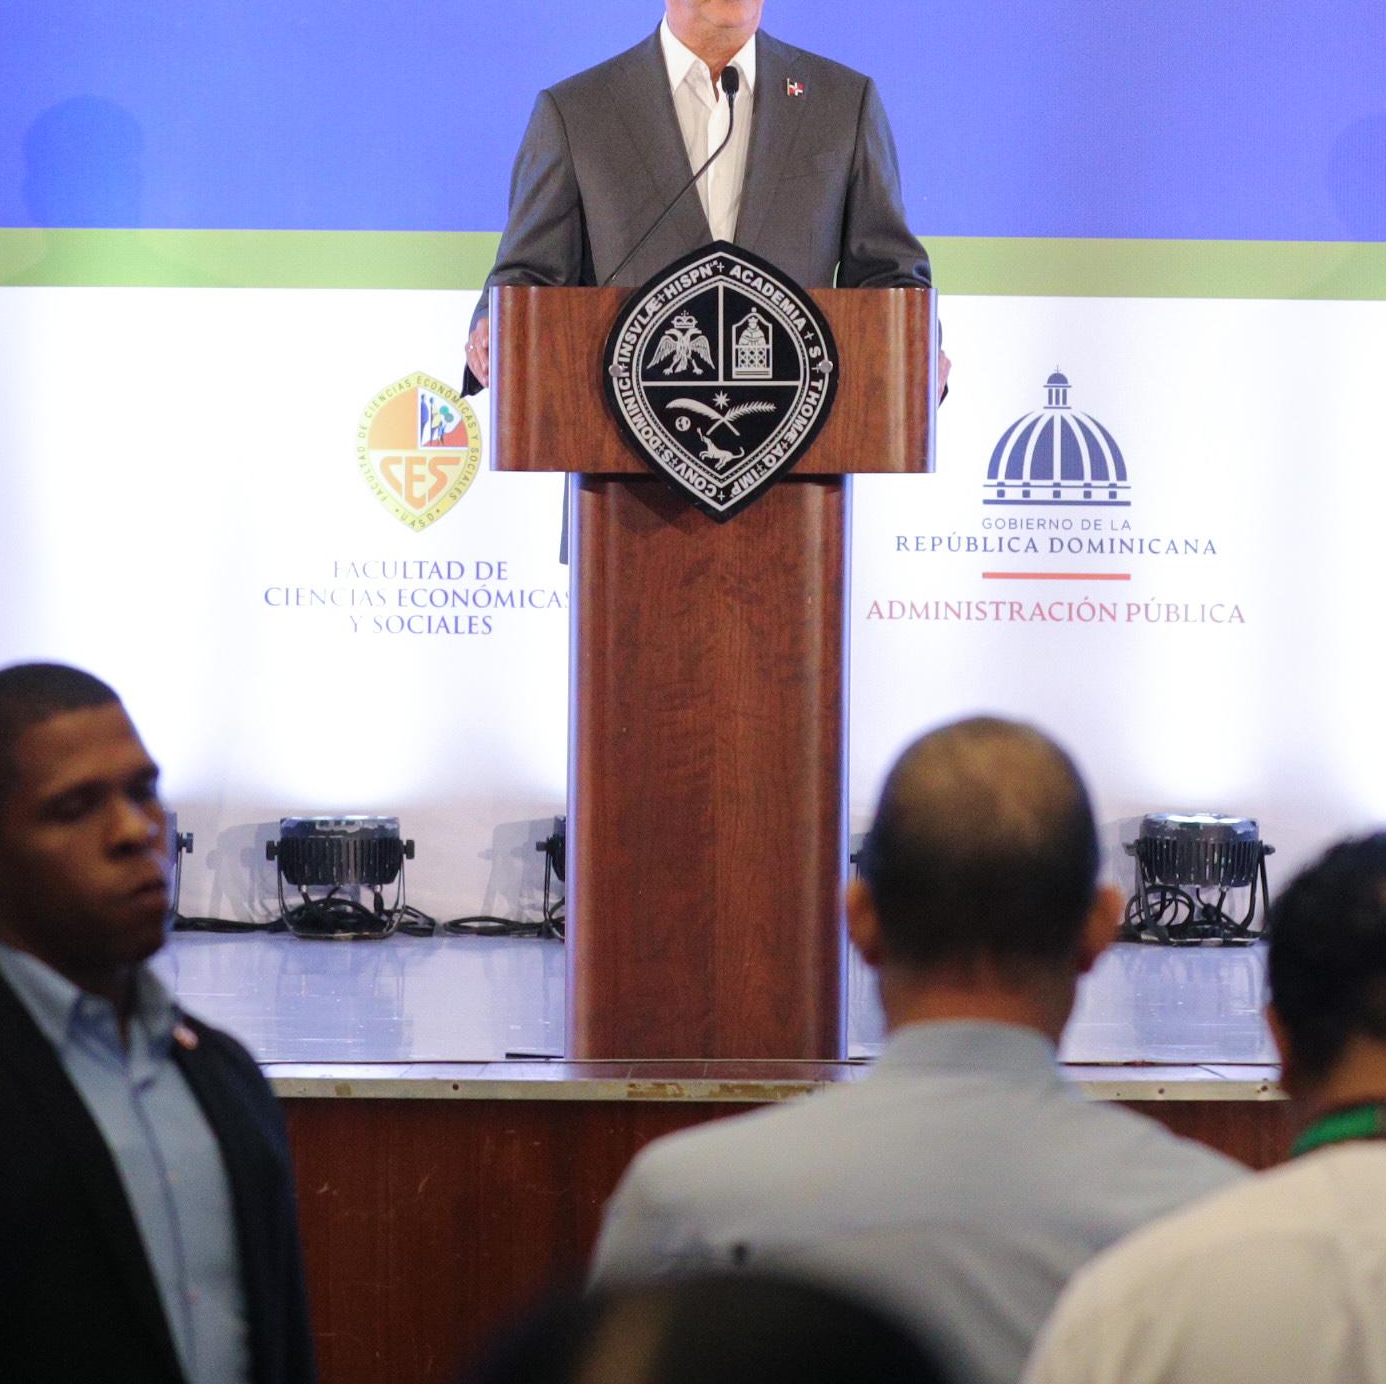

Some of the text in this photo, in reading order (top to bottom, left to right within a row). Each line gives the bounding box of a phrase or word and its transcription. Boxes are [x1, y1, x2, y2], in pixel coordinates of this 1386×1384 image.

[728, 264, 808, 332] ACADEMIA
[364, 379, 412, 419] CIENCIAS
[449, 447, 480, 501] SOCIALES
[400, 512, 435, 529] UASD
[981, 517, 1132, 532] GOBIERNO DE LA
[895, 530, 1219, 556] REPÚBLICA DOMINICANA
[333, 560, 509, 581] FACULTAD DE
[264, 587, 387, 607] CIENCIAS
[865, 596, 1247, 625] ADMINISTRACIÓN PÚBLICA
[373, 615, 493, 635] SOCIALES
